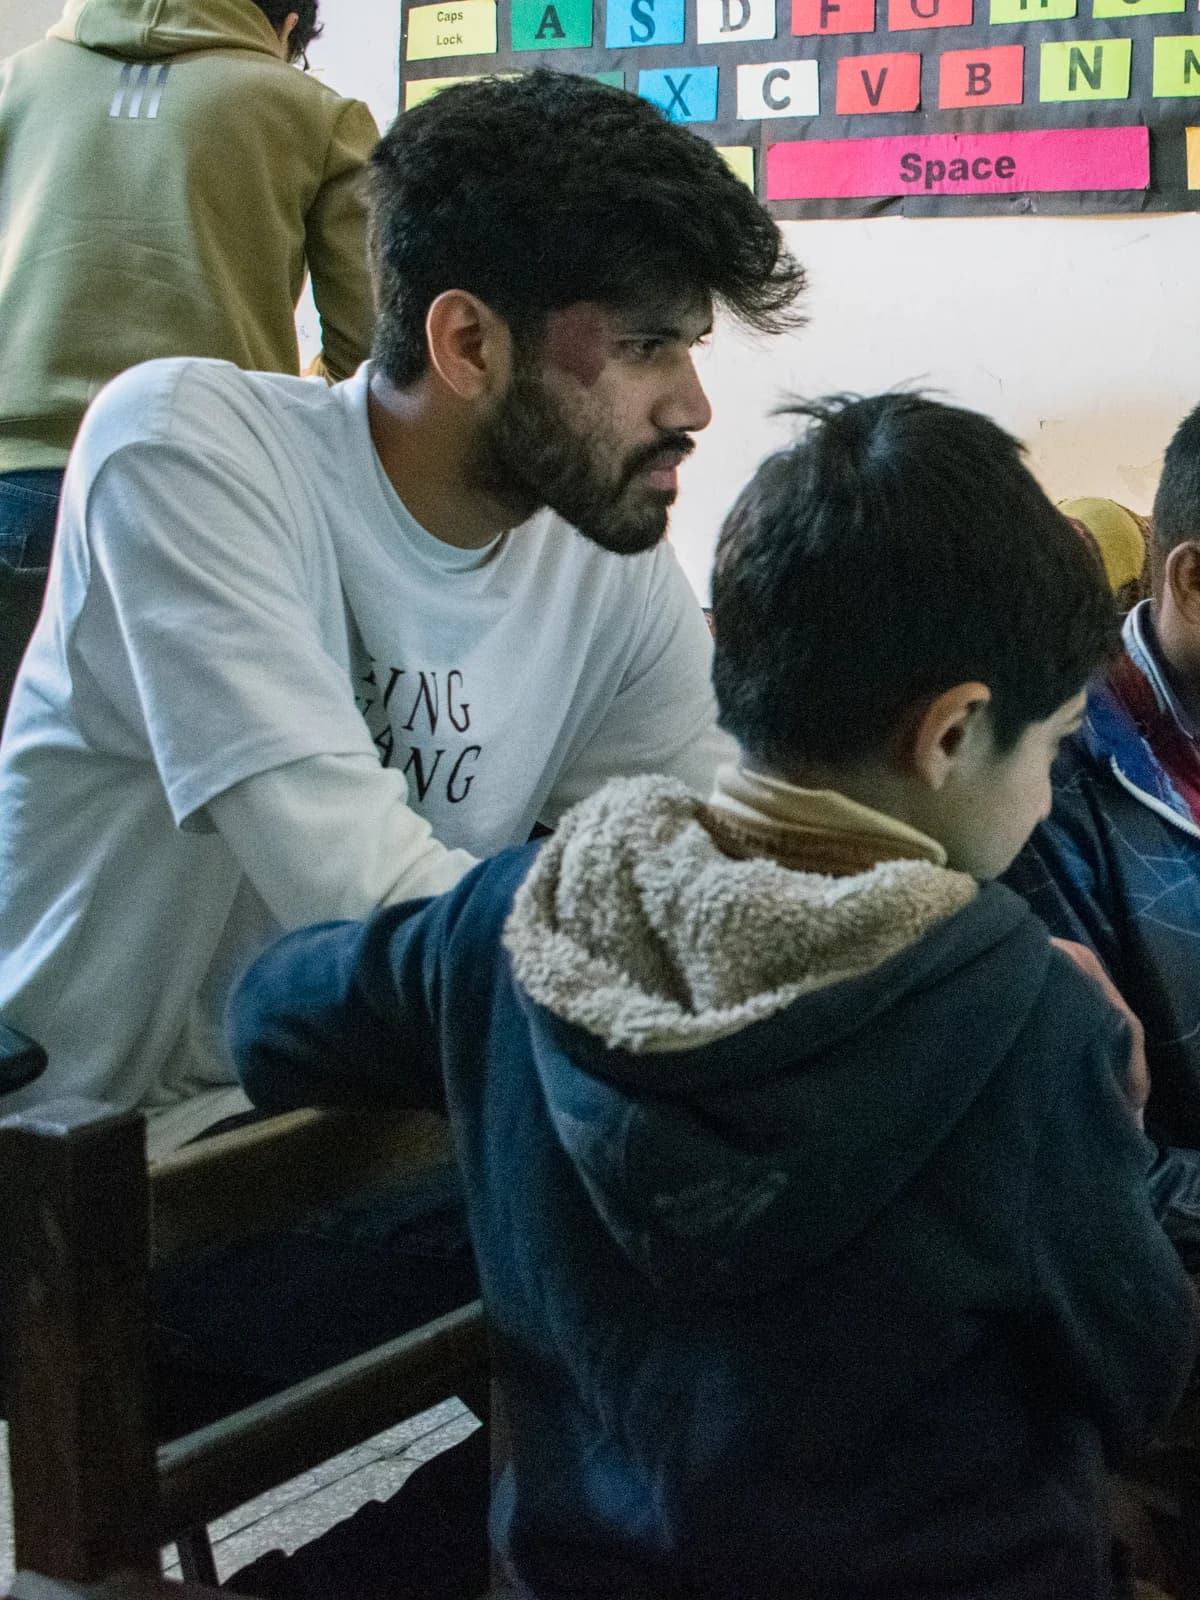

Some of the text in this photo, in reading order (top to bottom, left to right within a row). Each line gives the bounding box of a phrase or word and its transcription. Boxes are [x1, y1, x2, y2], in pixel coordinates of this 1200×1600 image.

[436, 10, 464, 23] Caps
[534, 3, 567, 40] A
[630, 0, 657, 43] S
[719, 0, 751, 33] D
[436, 33, 464, 46] Lock
[860, 67, 889, 107] V
[965, 62, 992, 97] B
[1068, 45, 1104, 92] N
[662, 73, 692, 117] X
[761, 67, 792, 111] C
[899, 152, 1017, 190] Space
